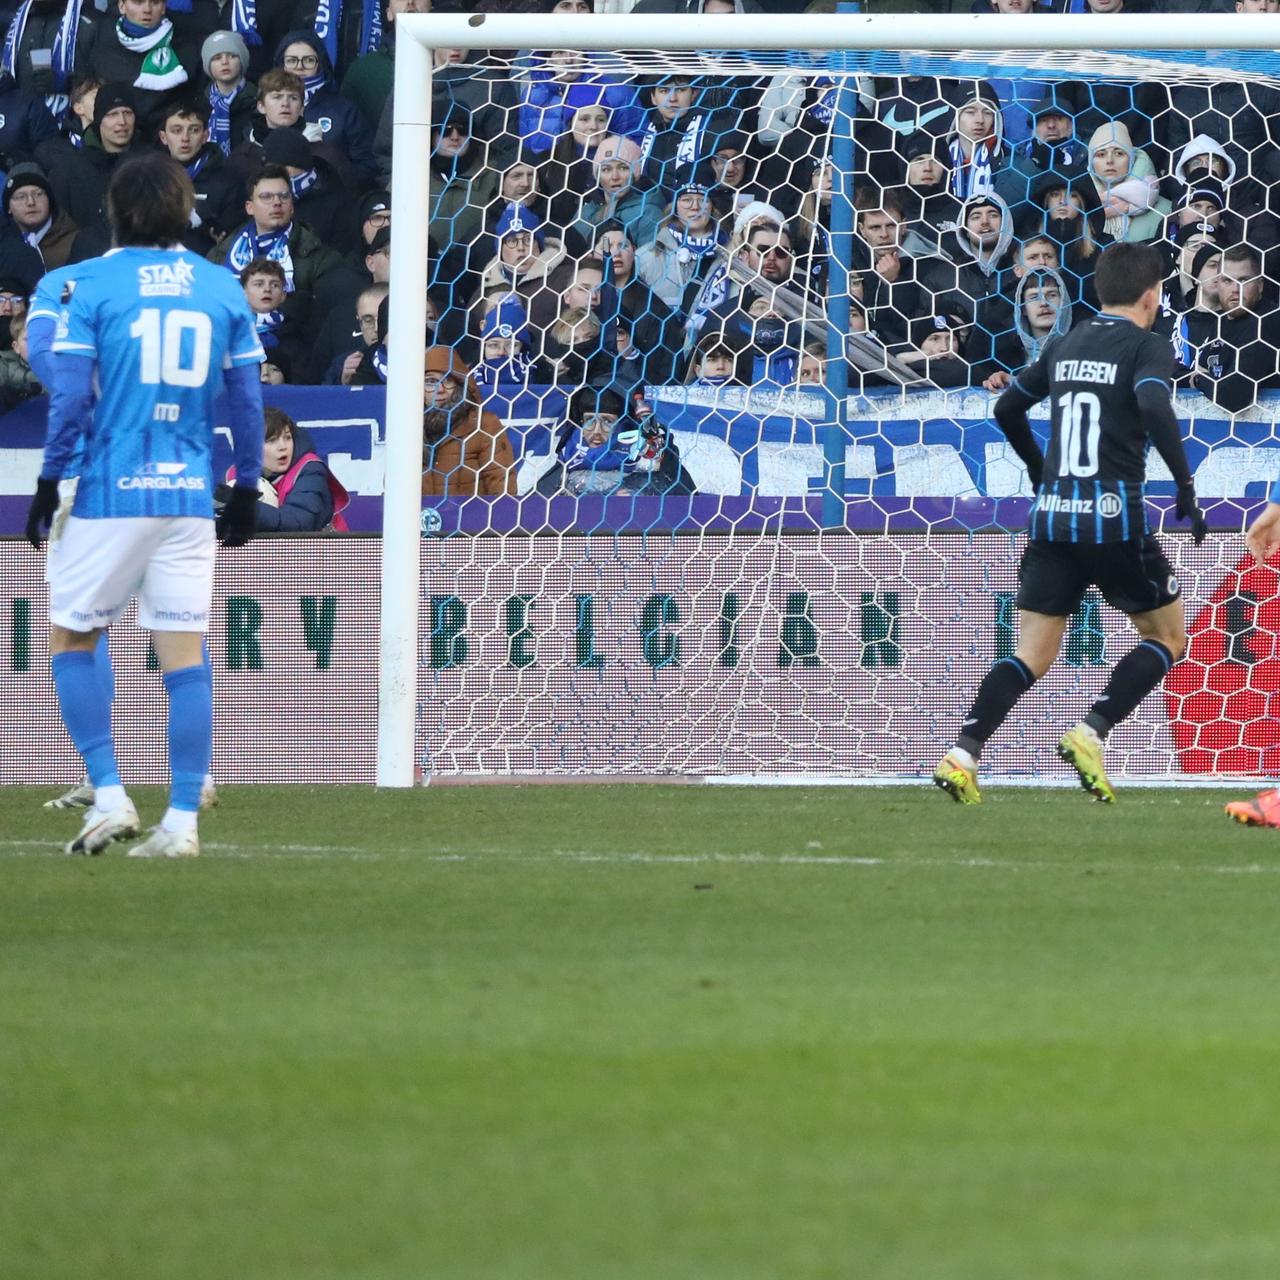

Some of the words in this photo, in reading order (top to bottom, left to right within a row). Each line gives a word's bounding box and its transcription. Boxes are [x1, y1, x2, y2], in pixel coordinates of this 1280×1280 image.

[138, 263, 191, 284] STAR
[130, 307, 212, 388] 10
[1055, 360, 1118, 386] VETLESEN
[153, 403, 181, 422] ITO
[1057, 391, 1101, 479] 10
[117, 476, 205, 491] CARGLASS
[1035, 493, 1093, 515] Allianz
[430, 591, 905, 670] BELGIAN
